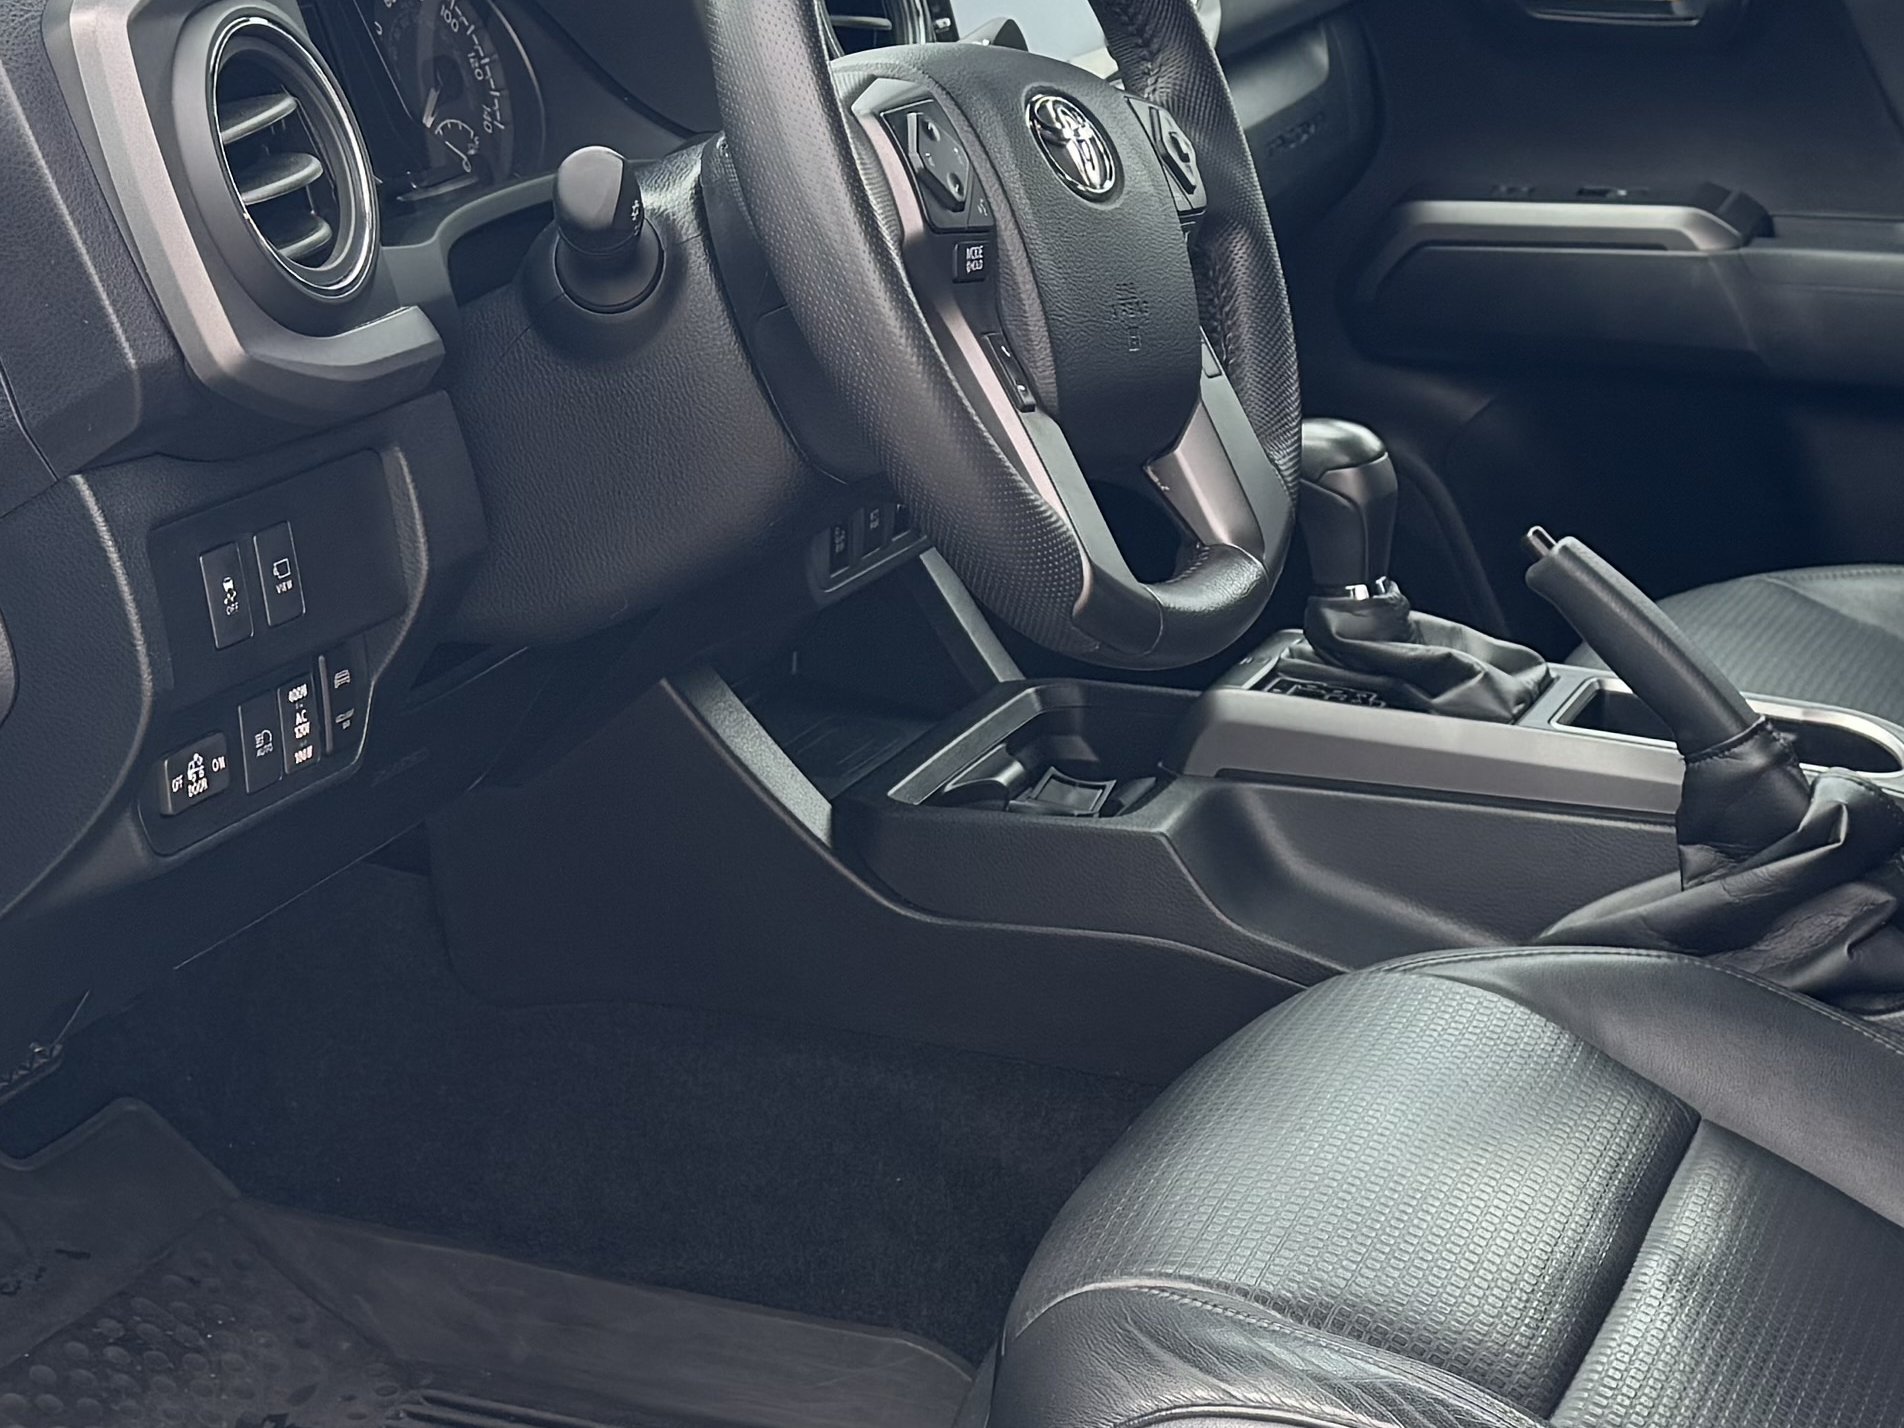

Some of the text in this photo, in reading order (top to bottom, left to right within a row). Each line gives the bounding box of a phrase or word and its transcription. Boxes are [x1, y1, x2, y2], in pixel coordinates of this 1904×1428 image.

[440, 6, 459, 33] 100
[467, 52, 483, 80] 120
[482, 103, 493, 134] 140
[296, 709, 308, 726] AC
[256, 744, 274, 758] AUTO
[211, 756, 226, 772] ON
